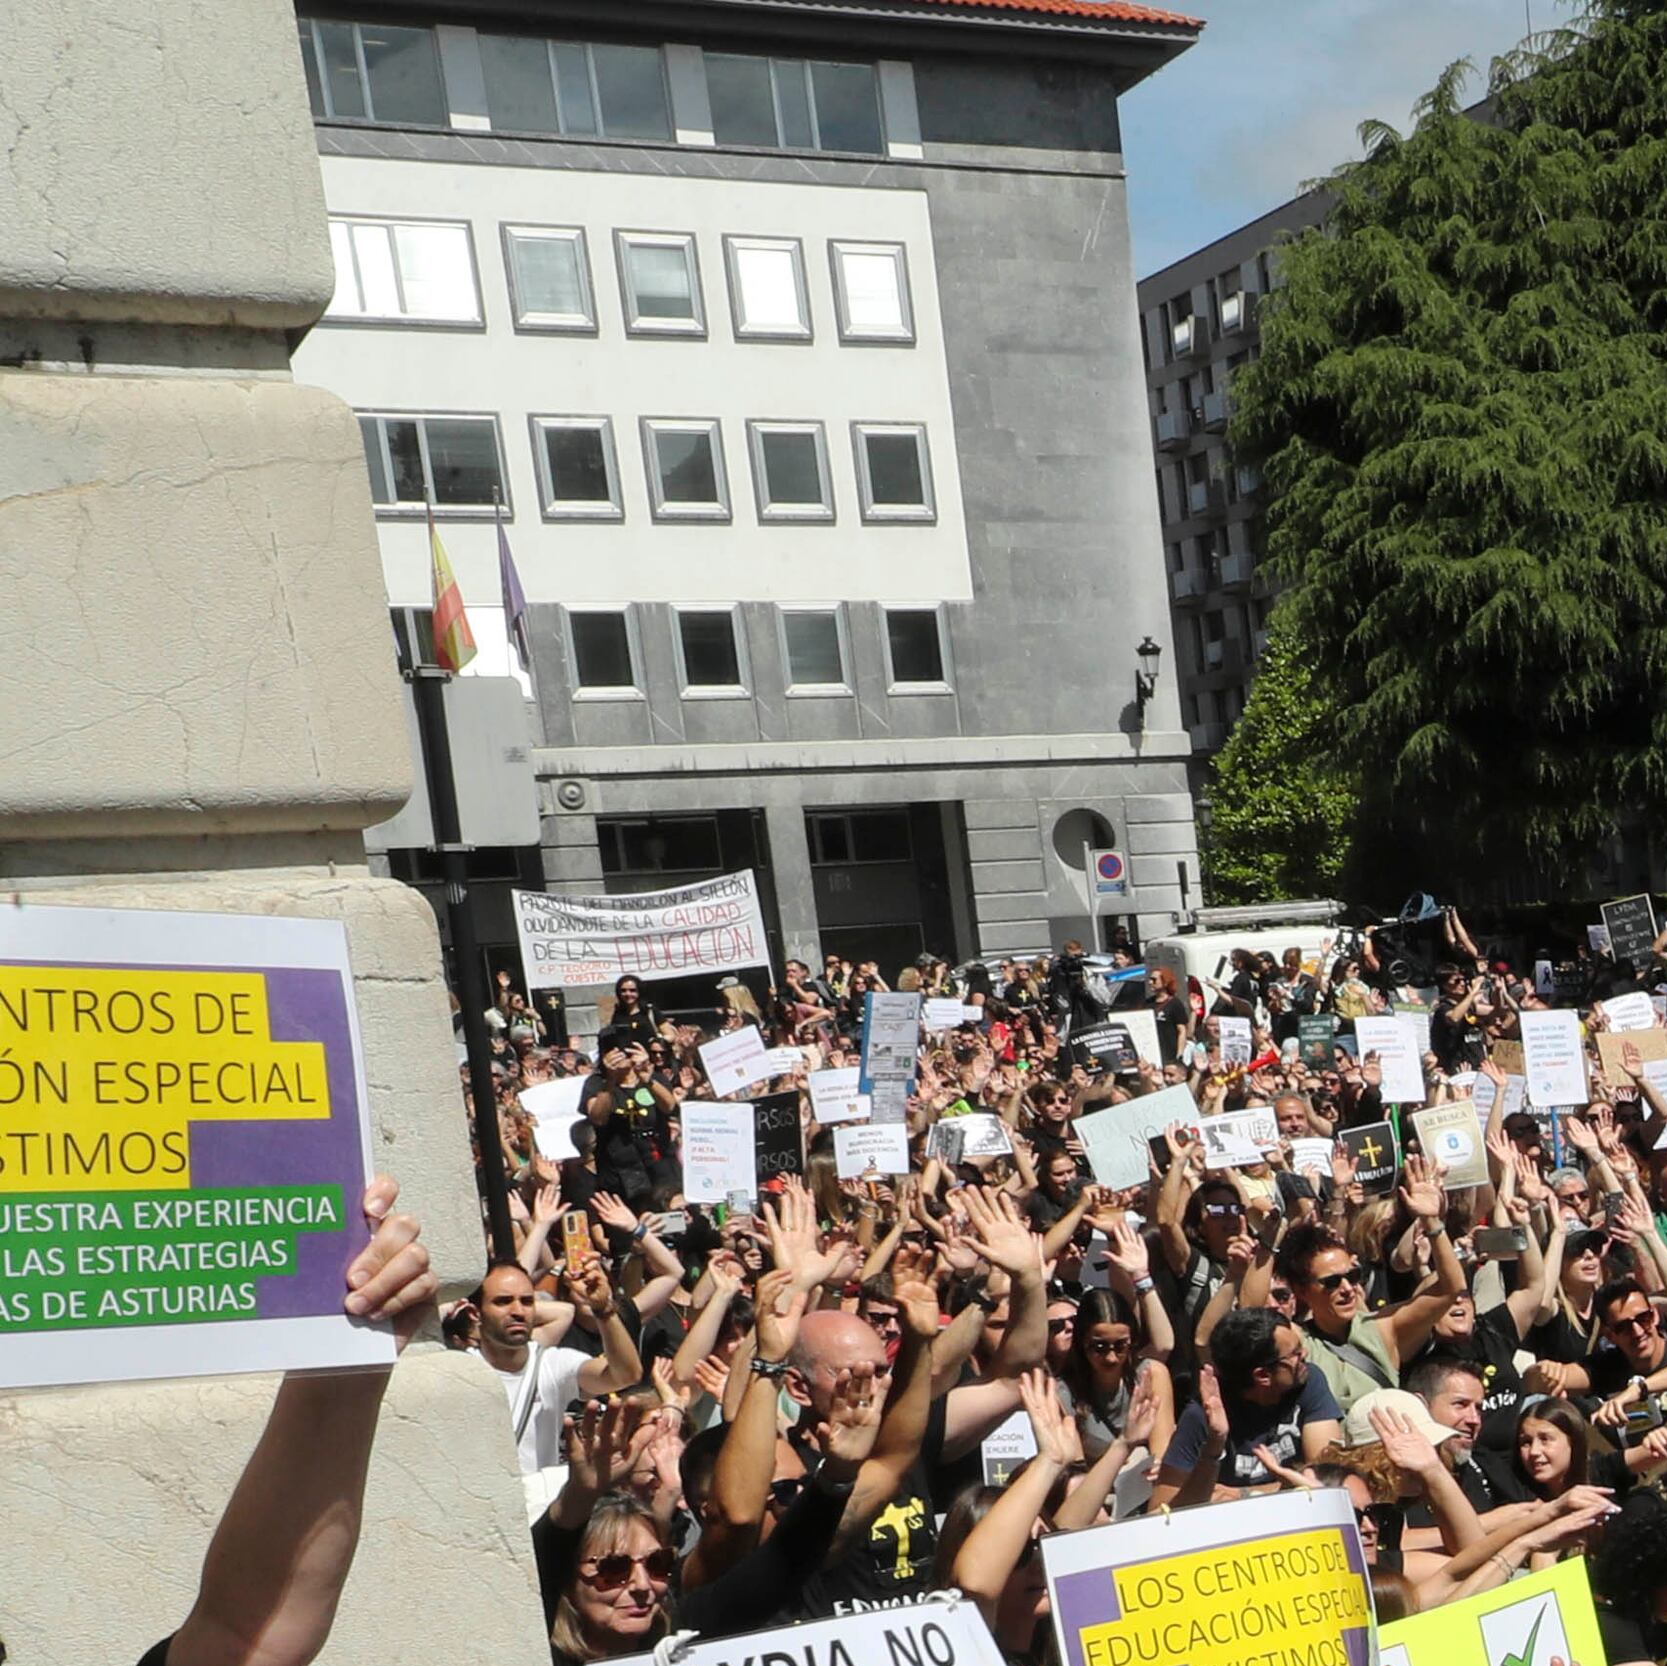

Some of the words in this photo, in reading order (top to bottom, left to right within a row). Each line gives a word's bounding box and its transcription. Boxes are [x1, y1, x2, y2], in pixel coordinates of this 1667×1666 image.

[613, 914, 630, 931] DE
[635, 913, 655, 929] LA
[662, 902, 742, 928] CALIDAD
[682, 891, 696, 904] AL
[533, 942, 559, 962] DE
[567, 939, 599, 961] LA
[0, 988, 175, 1035] NTROS
[194, 992, 254, 1036] DE
[95, 1061, 316, 1104] ESPECIAL
[0, 1131, 187, 1176] TIMOS
[134, 1196, 337, 1230] EXPERIENCIA
[4, 1247, 66, 1278] LAS
[77, 1238, 289, 1274] ESTRATEGIAS
[42, 1291, 88, 1319] DE
[97, 1282, 257, 1317] ASTURIAS
[1118, 1571, 1185, 1616] LOS
[1194, 1546, 1319, 1597] CENTROS
[1322, 1541, 1347, 1573] DE
[1295, 1587, 1367, 1628] ESPECIAL
